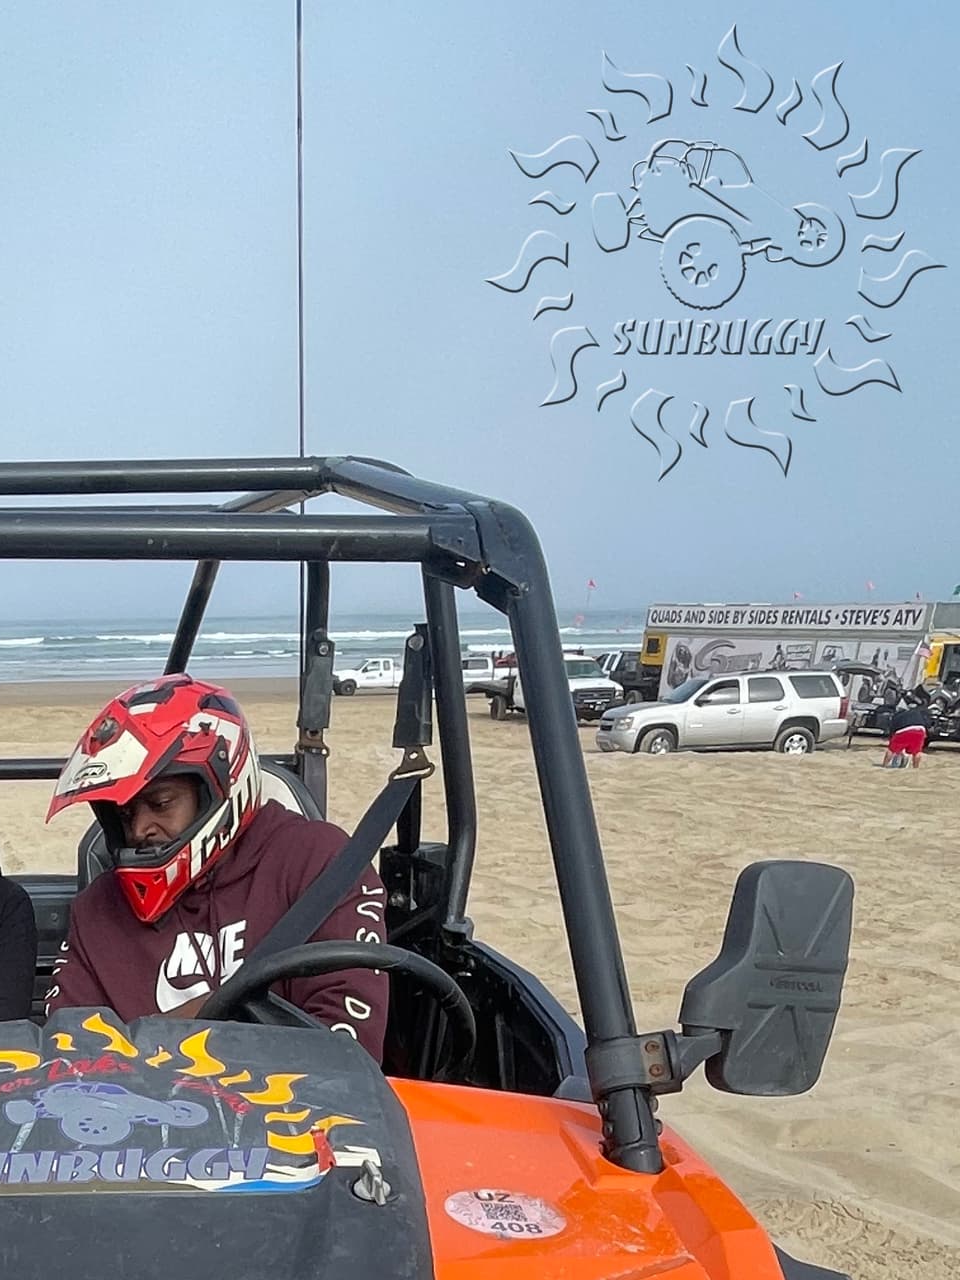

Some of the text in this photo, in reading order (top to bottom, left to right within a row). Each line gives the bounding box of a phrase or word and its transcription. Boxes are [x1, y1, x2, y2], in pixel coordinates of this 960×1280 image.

[650, 608, 923, 627] QUADS AND SIDE BY SIDES RENTALS STEVE'S ATV
[490, 1221, 543, 1234] 408
